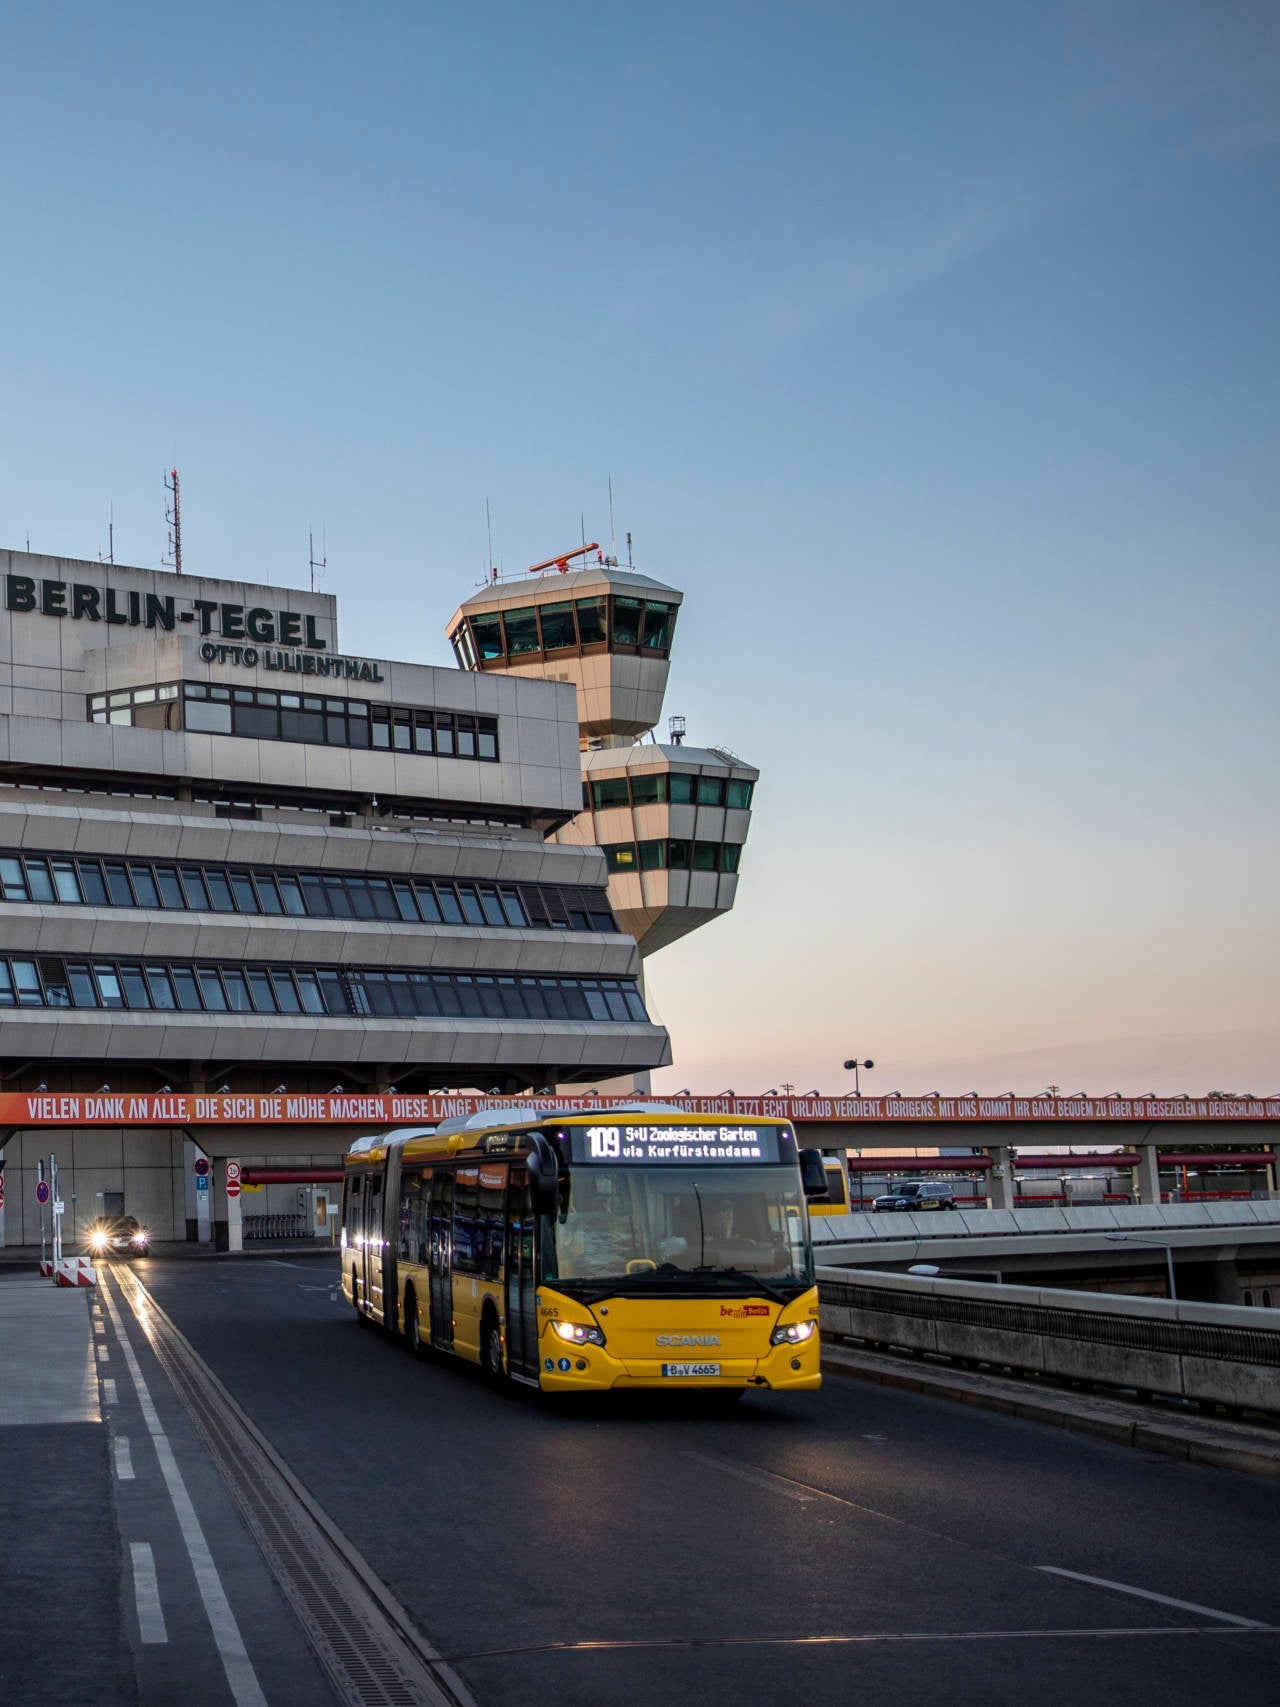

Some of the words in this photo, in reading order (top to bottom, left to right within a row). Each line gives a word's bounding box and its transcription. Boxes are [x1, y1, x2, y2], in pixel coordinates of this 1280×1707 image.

[5, 574, 326, 649] BERLIN-TEGEL
[199, 642, 259, 667] OTTO
[264, 648, 384, 682] LILIENTHAL
[27, 1098, 79, 1119] VIELEN
[85, 1098, 124, 1119] DANK
[128, 1098, 148, 1119] AN
[153, 1098, 190, 1121] ALLE,
[195, 1098, 218, 1119] DIE
[223, 1098, 255, 1119] SICH
[260, 1098, 282, 1118] DIE
[286, 1096, 325, 1118] MÜHE
[330, 1098, 388, 1121] MACHEN,
[392, 1099, 428, 1118] DIESE
[432, 1099, 472, 1118] LANGE
[763, 1100, 788, 1117] ECHT
[791, 1100, 831, 1117] URLAUB
[834, 1100, 883, 1117] VERDIENT.
[886, 1098, 936, 1117] ÜBRIGENS:
[939, 1100, 955, 1117] MIT
[958, 1101, 977, 1117] UNS
[979, 1101, 1011, 1117] KOMMT
[1014, 1101, 1030, 1117] IHR
[1032, 1101, 1055, 1117] GANZ
[1058, 1101, 1093, 1117] BEQUEM
[1096, 1101, 1107, 1117] ZU
[1109, 1101, 1131, 1117] ÜBER
[1133, 1101, 1144, 1117] 90
[1146, 1101, 1196, 1117] REISEZIELEN
[1199, 1101, 1207, 1117] IN
[1209, 1101, 1264, 1117] DEUTSCHLAND
[586, 1127, 620, 1157] 109
[625, 1128, 648, 1142] S+U
[649, 1128, 717, 1144] Zoologischer
[719, 1128, 757, 1142] Garten
[622, 1145, 643, 1158] via
[648, 1145, 761, 1158] Kurfürstendamm
[540, 1308, 559, 1317] 4665
[720, 1305, 733, 1316] be
[656, 1335, 720, 1346] SCANIA
[671, 1365, 677, 1375] B
[683, 1365, 690, 1375] V
[692, 1364, 715, 1375] 4665
